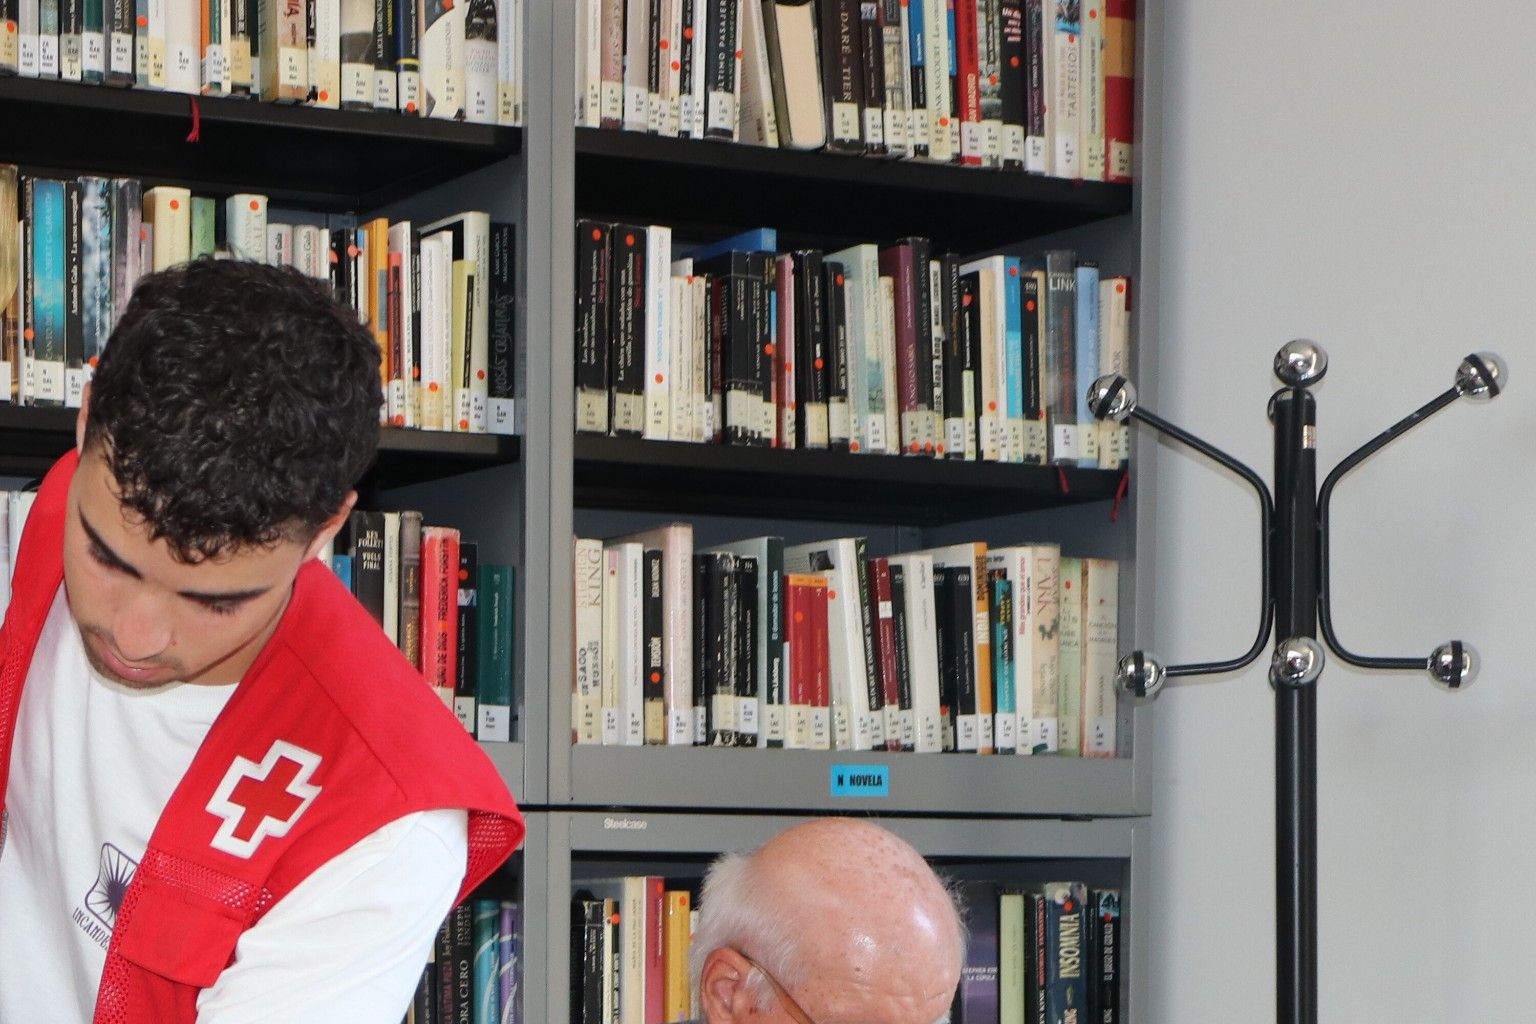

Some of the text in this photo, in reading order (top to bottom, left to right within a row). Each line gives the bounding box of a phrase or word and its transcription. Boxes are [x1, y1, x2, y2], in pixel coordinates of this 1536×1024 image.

[69, 243, 78, 254] La
[69, 264, 78, 283] Gala
[365, 530, 379, 539] KEN
[363, 560, 380, 570] FINAL
[588, 548, 601, 608] KING
[849, 774, 883, 787] NOVELA
[1058, 912, 1080, 979] INSOMNIA
[459, 959, 469, 999] CERO
